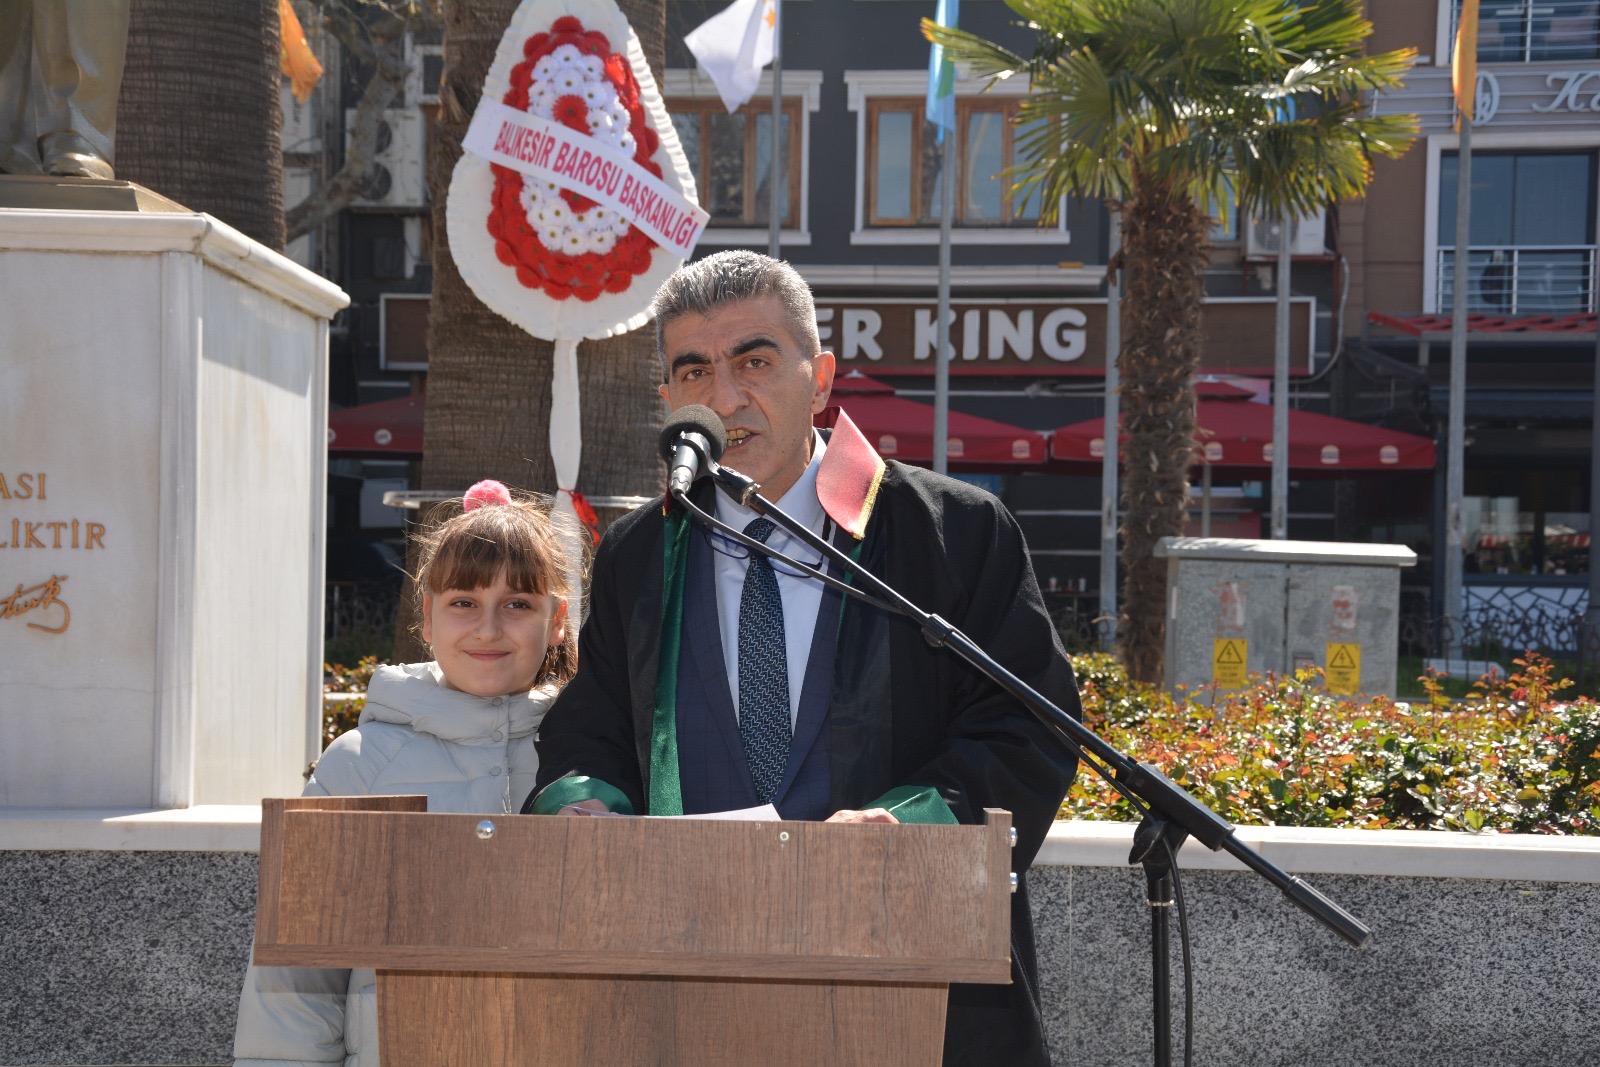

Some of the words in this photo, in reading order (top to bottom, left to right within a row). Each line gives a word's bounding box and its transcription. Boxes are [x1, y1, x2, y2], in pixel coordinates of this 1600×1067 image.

[552, 141, 624, 197] BAROSU
[618, 173, 699, 249] BAŞKANLIĞI
[914, 308, 1087, 361] KING
[0, 518, 106, 550] İKTİR
